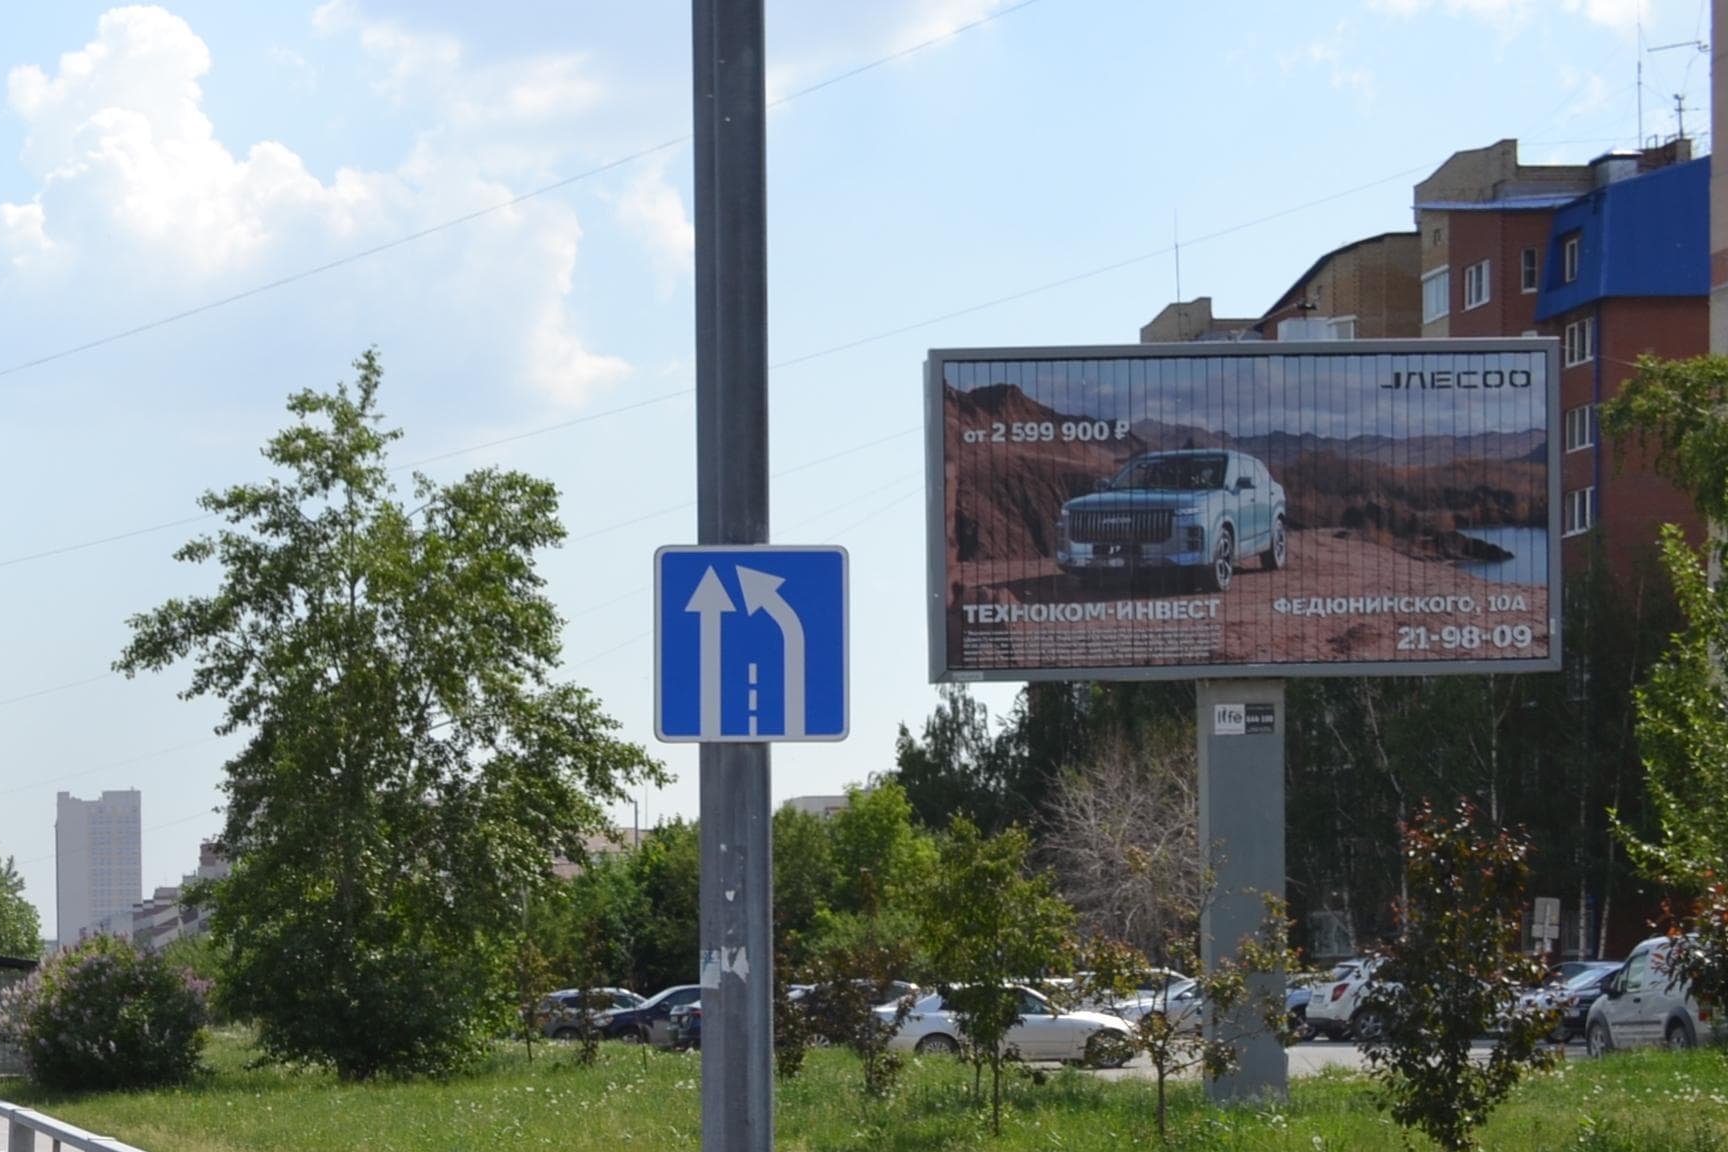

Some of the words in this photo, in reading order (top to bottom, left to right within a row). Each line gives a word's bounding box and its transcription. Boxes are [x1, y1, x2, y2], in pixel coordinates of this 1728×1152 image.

[1380, 370, 1531, 389] JAECOO
[964, 430, 986, 443] от
[991, 423, 1006, 442] 2
[1011, 422, 1054, 441] 599
[1061, 421, 1109, 441] 900
[963, 600, 1220, 623] ТЕХНОКОМ-ИНВЕСТ
[1273, 597, 1481, 617] ФЕДЮНИНСКОГО,
[1488, 595, 1527, 612] 10А
[1397, 625, 1532, 649] 21-98-09
